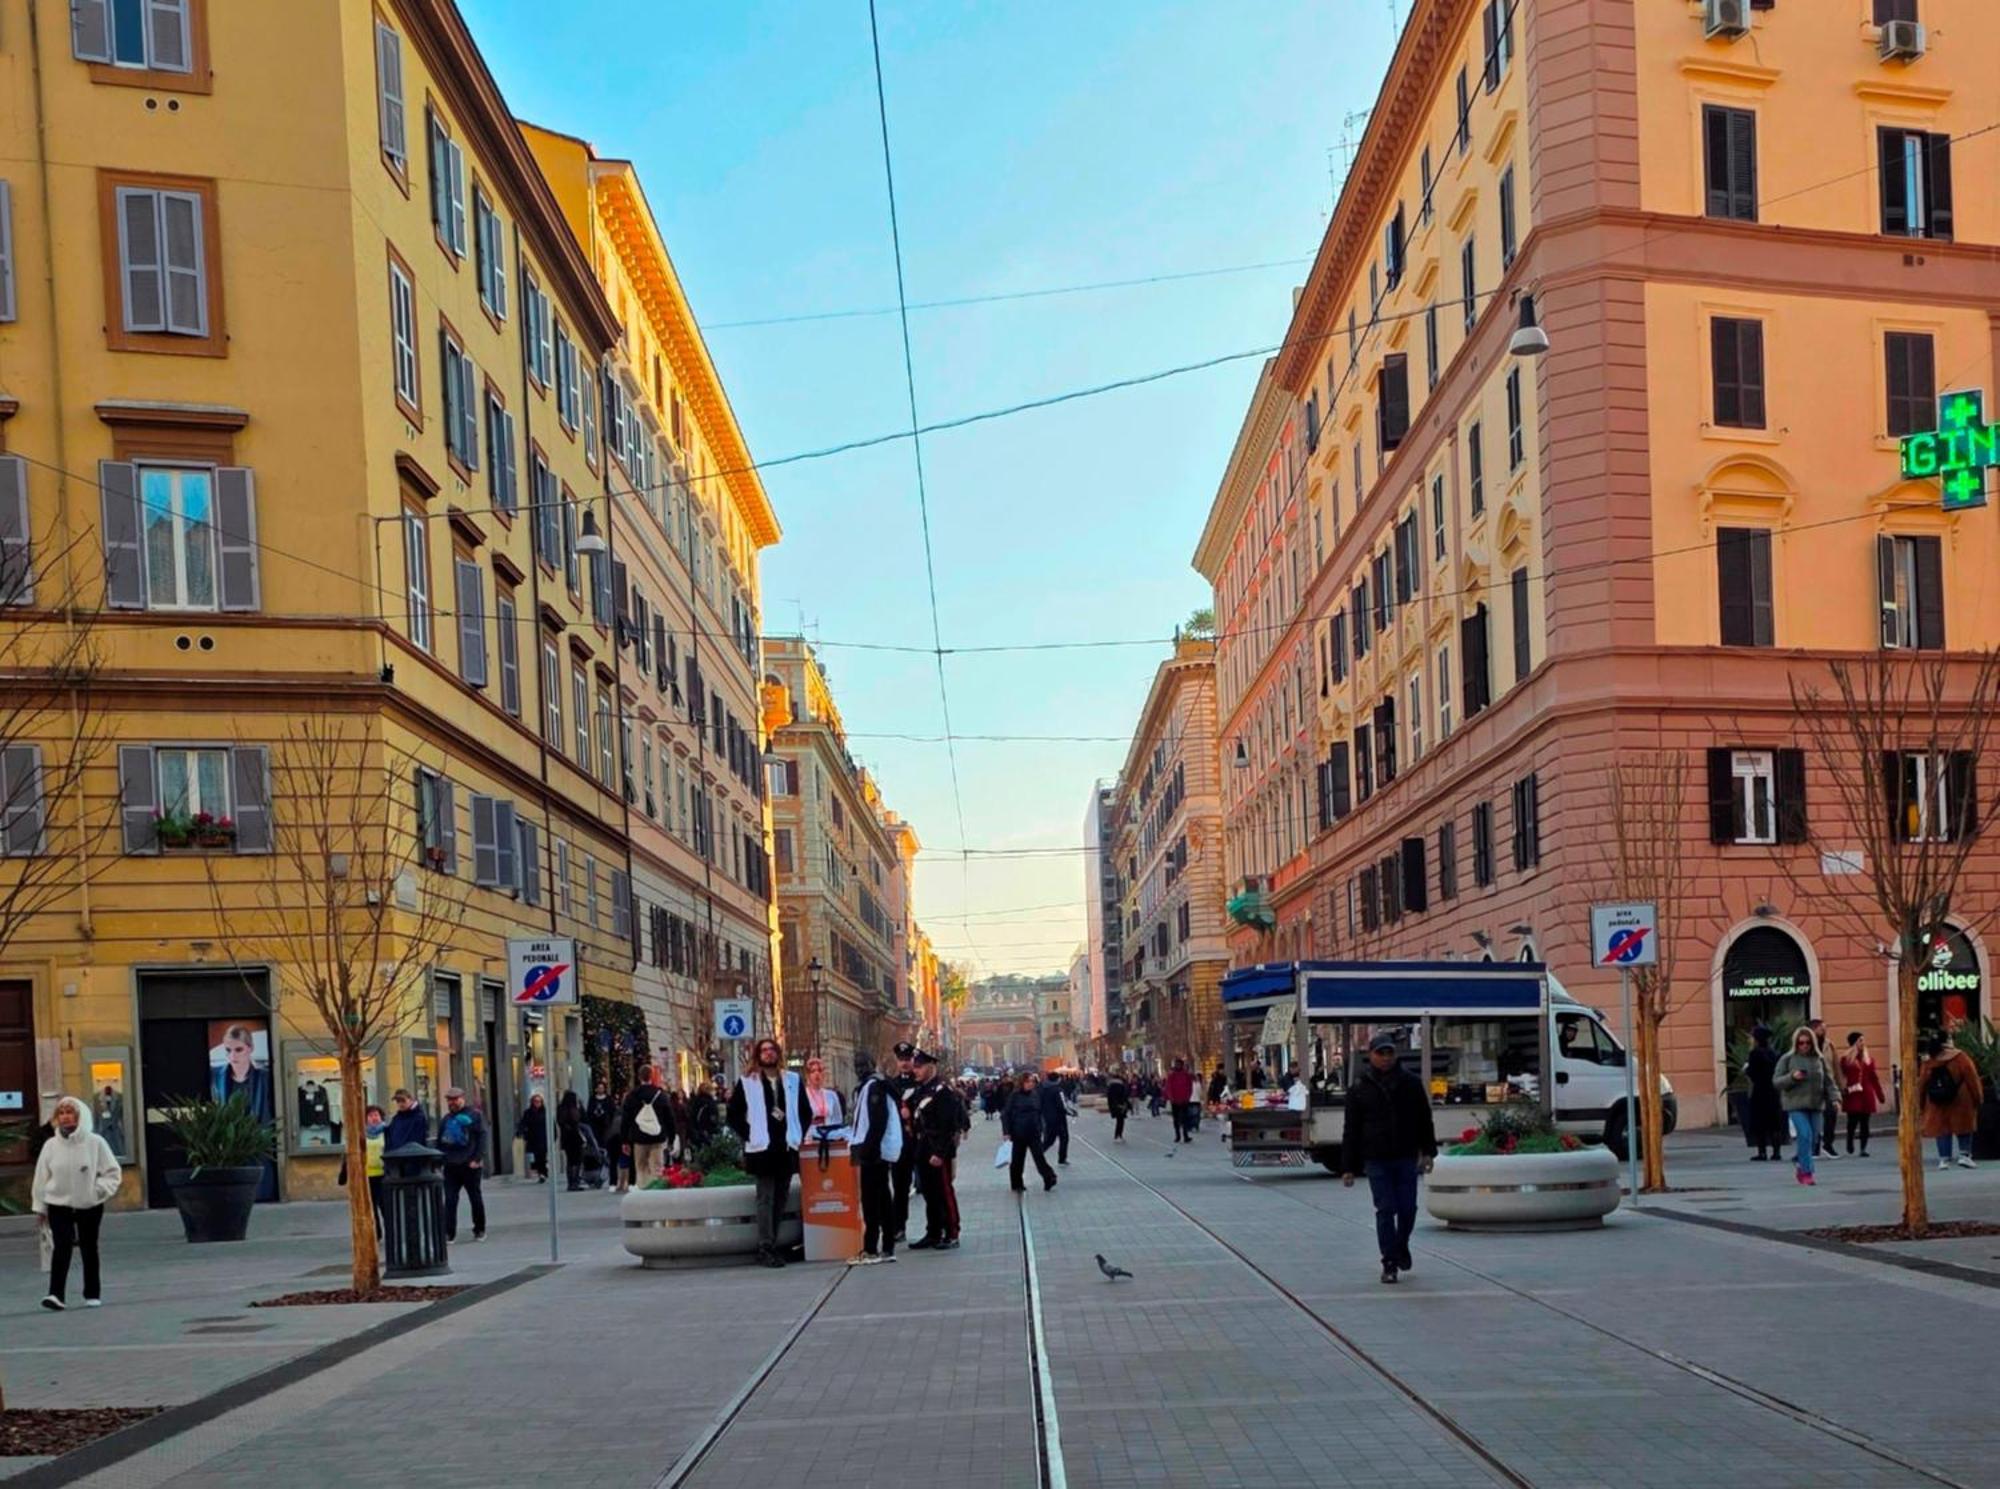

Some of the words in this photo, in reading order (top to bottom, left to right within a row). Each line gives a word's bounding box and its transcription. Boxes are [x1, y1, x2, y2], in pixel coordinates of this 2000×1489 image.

[1902, 426, 1996, 475] GIN
[531, 943, 551, 952] AREA
[522, 954, 560, 963] PEDONALE
[1744, 978, 1766, 987] HOME
[1767, 977, 1778, 986] OF
[1779, 976, 1794, 985] THE
[1918, 969, 1977, 991] ollibee
[1729, 987, 1761, 997] FAMOUS
